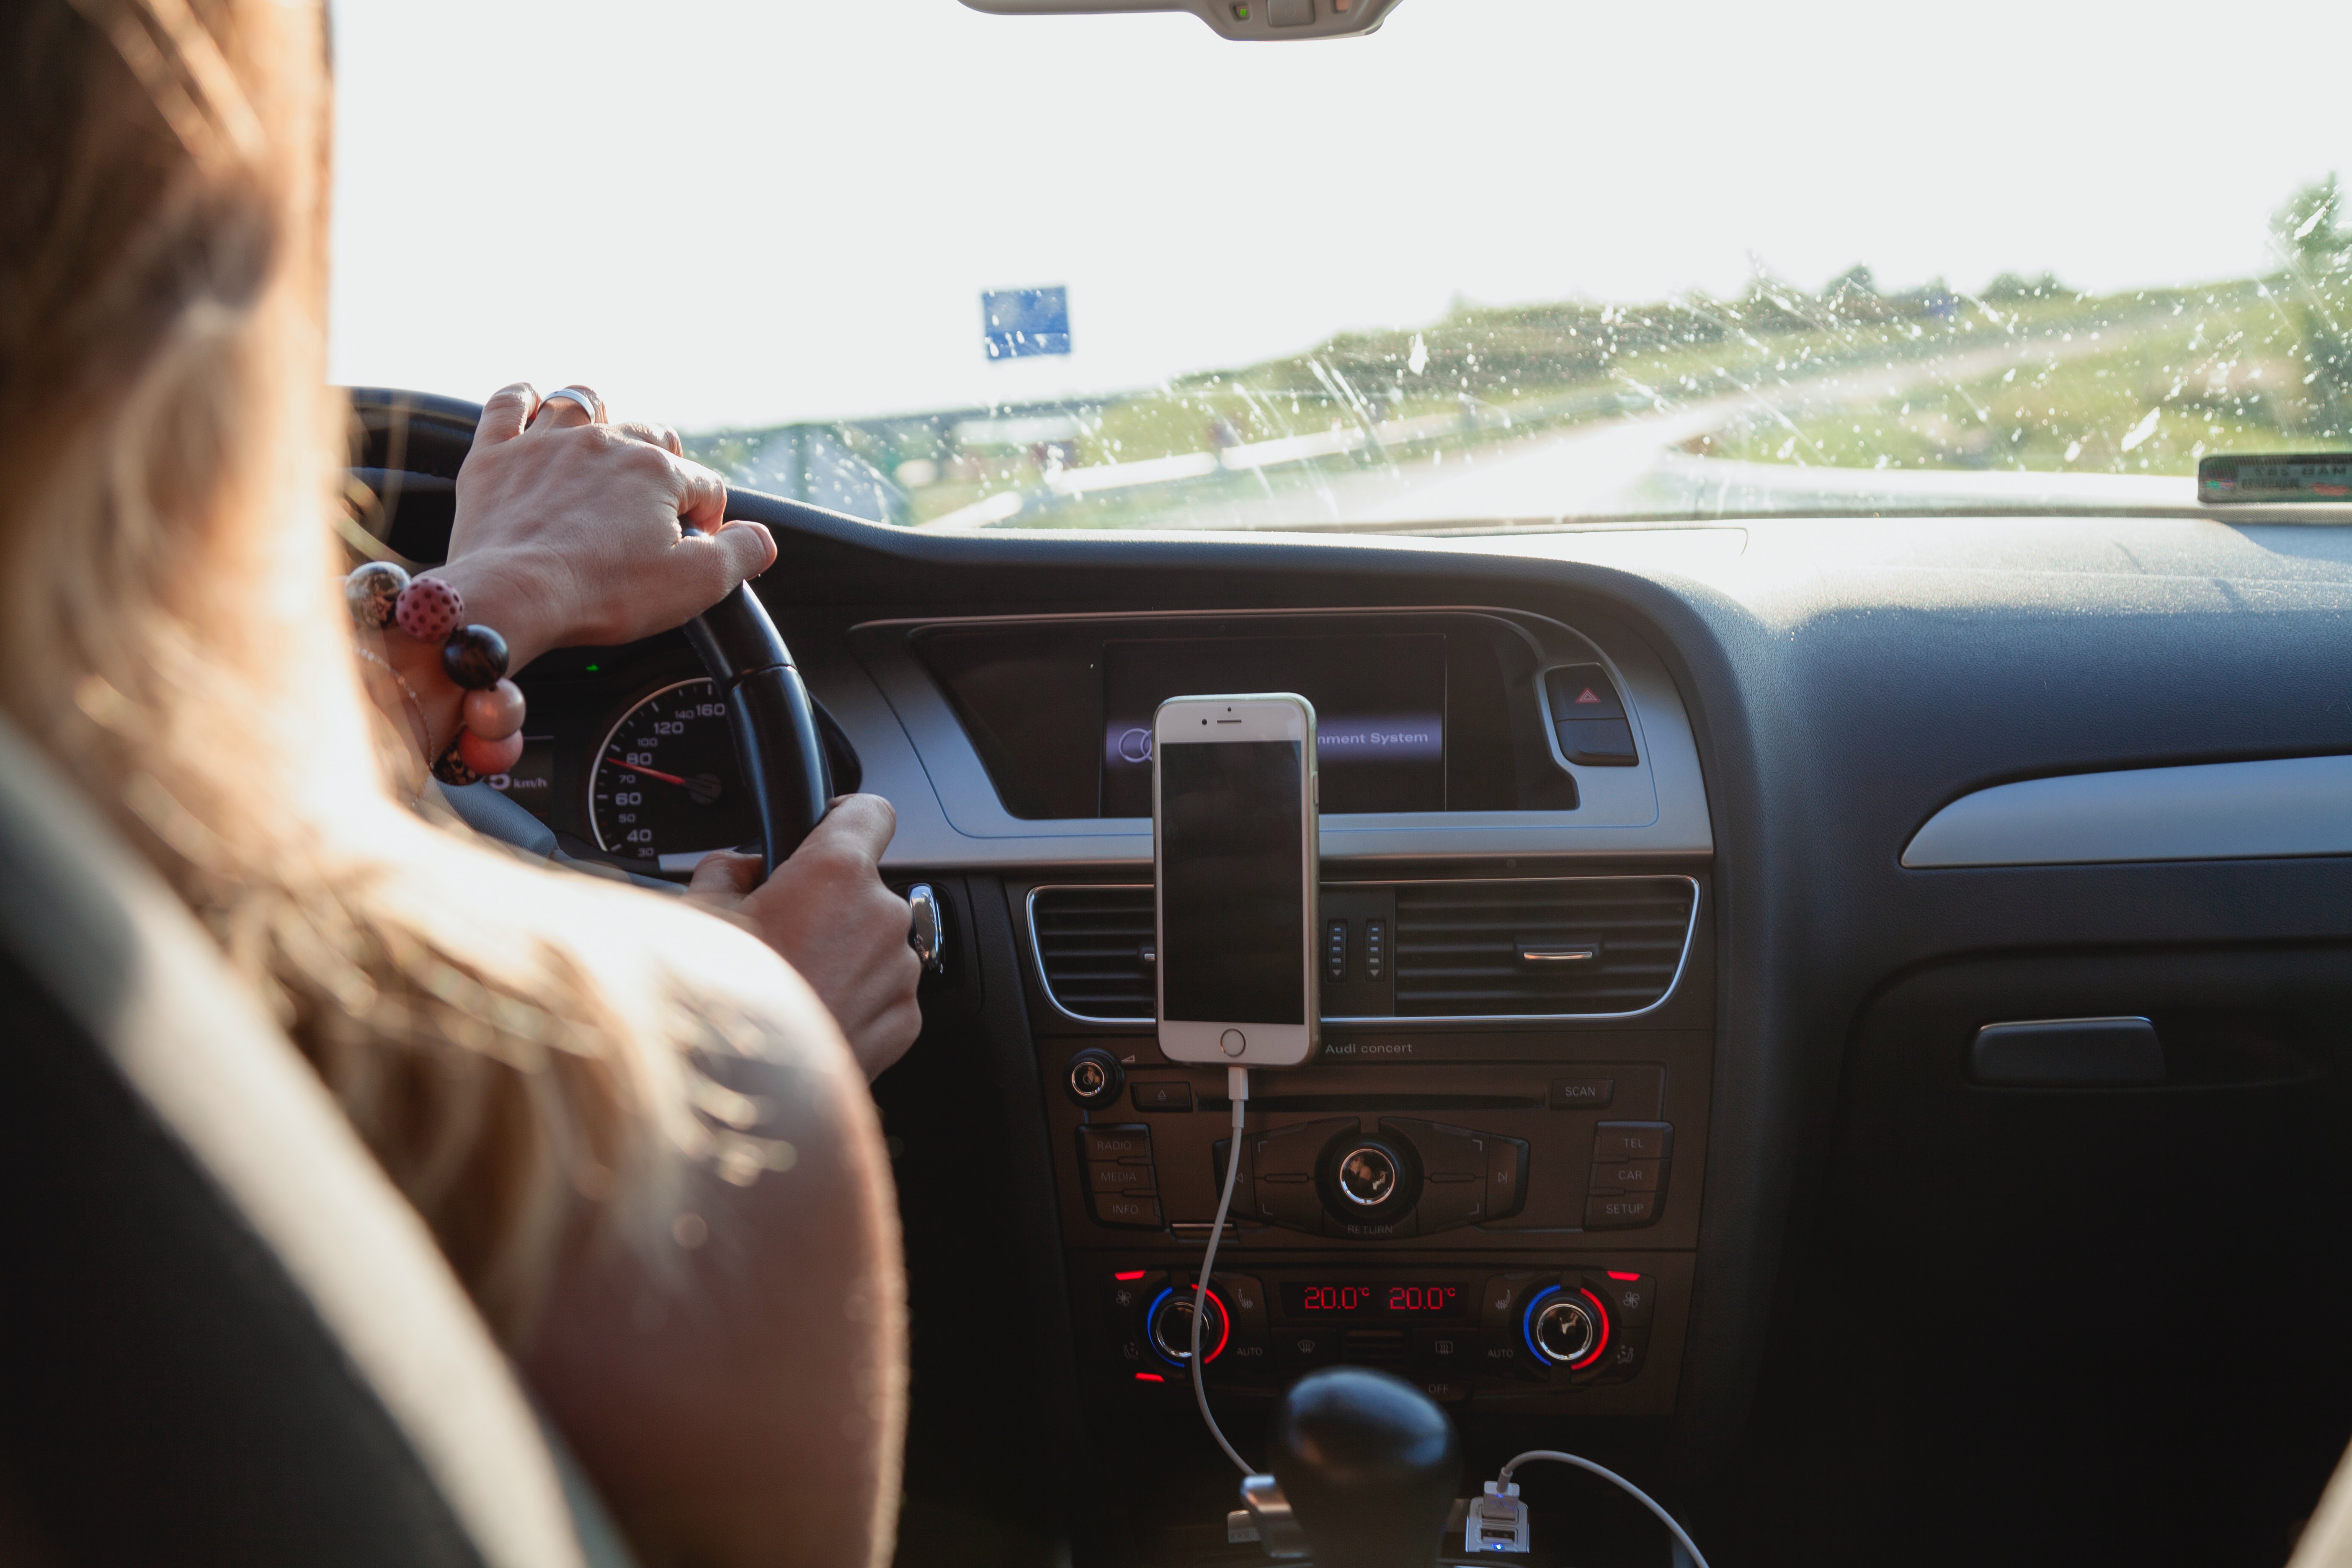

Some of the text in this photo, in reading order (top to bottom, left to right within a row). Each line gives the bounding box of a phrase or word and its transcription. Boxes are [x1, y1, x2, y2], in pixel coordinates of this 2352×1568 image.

[675, 710, 694, 720] 140
[696, 703, 725, 717] 160
[653, 722, 684, 735] 120
[637, 738, 658, 747] 100
[1317, 732, 1429, 746] nment System
[627, 753, 652, 766] 80
[513, 777, 548, 789] km/h
[619, 775, 636, 784] 70
[615, 792, 642, 806] 60
[619, 814, 636, 823] 50
[627, 829, 652, 842] 40
[638, 848, 654, 856] 30
[1325, 1043, 1413, 1054] Audi concert
[1565, 1086, 1596, 1097] SCAN
[1096, 1140, 1132, 1150] RADIO
[1623, 1138, 1644, 1148] TEL
[1101, 1172, 1137, 1182] MEDIA
[1619, 1171, 1643, 1180] CAR
[1112, 1204, 1139, 1214] INFO
[1606, 1204, 1644, 1215] SETUP
[1347, 1225, 1393, 1235] RETURN
[1237, 1347, 1263, 1357] AUTO
[1487, 1349, 1514, 1359] AUTO
[1429, 1384, 1449, 1394] OFF
